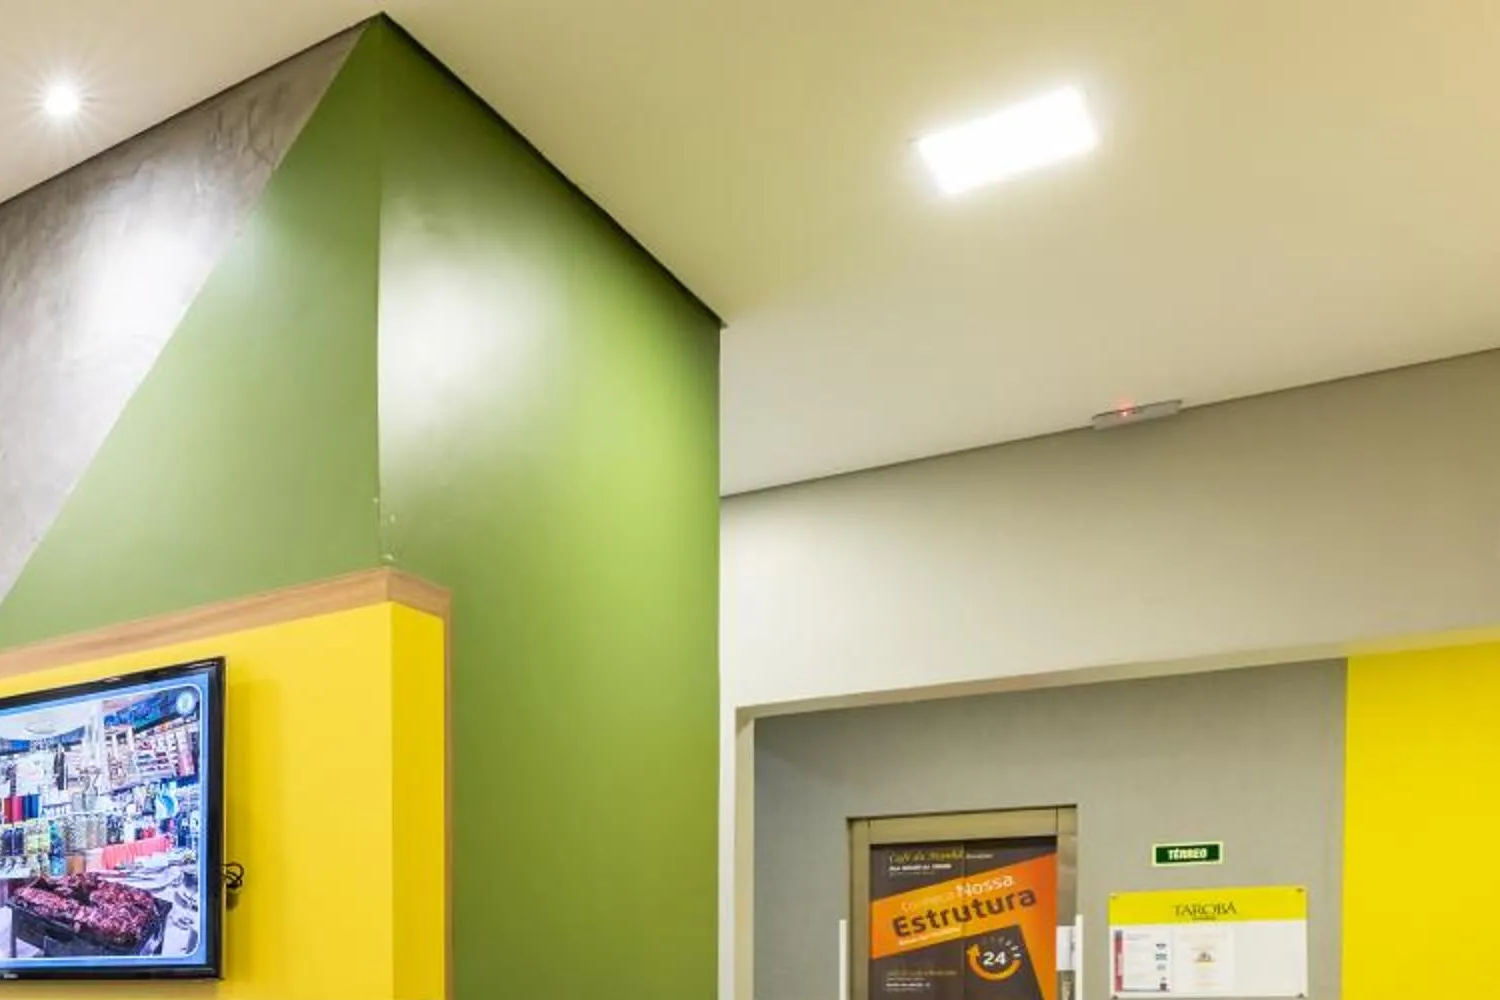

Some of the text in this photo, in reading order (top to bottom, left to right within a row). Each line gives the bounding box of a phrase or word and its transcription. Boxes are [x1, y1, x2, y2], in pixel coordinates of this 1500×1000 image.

[1167, 846, 1208, 862] TÉRREO
[955, 874, 1015, 898] Nossa
[892, 888, 1037, 938] Estrutura
[982, 950, 1007, 966] 24
